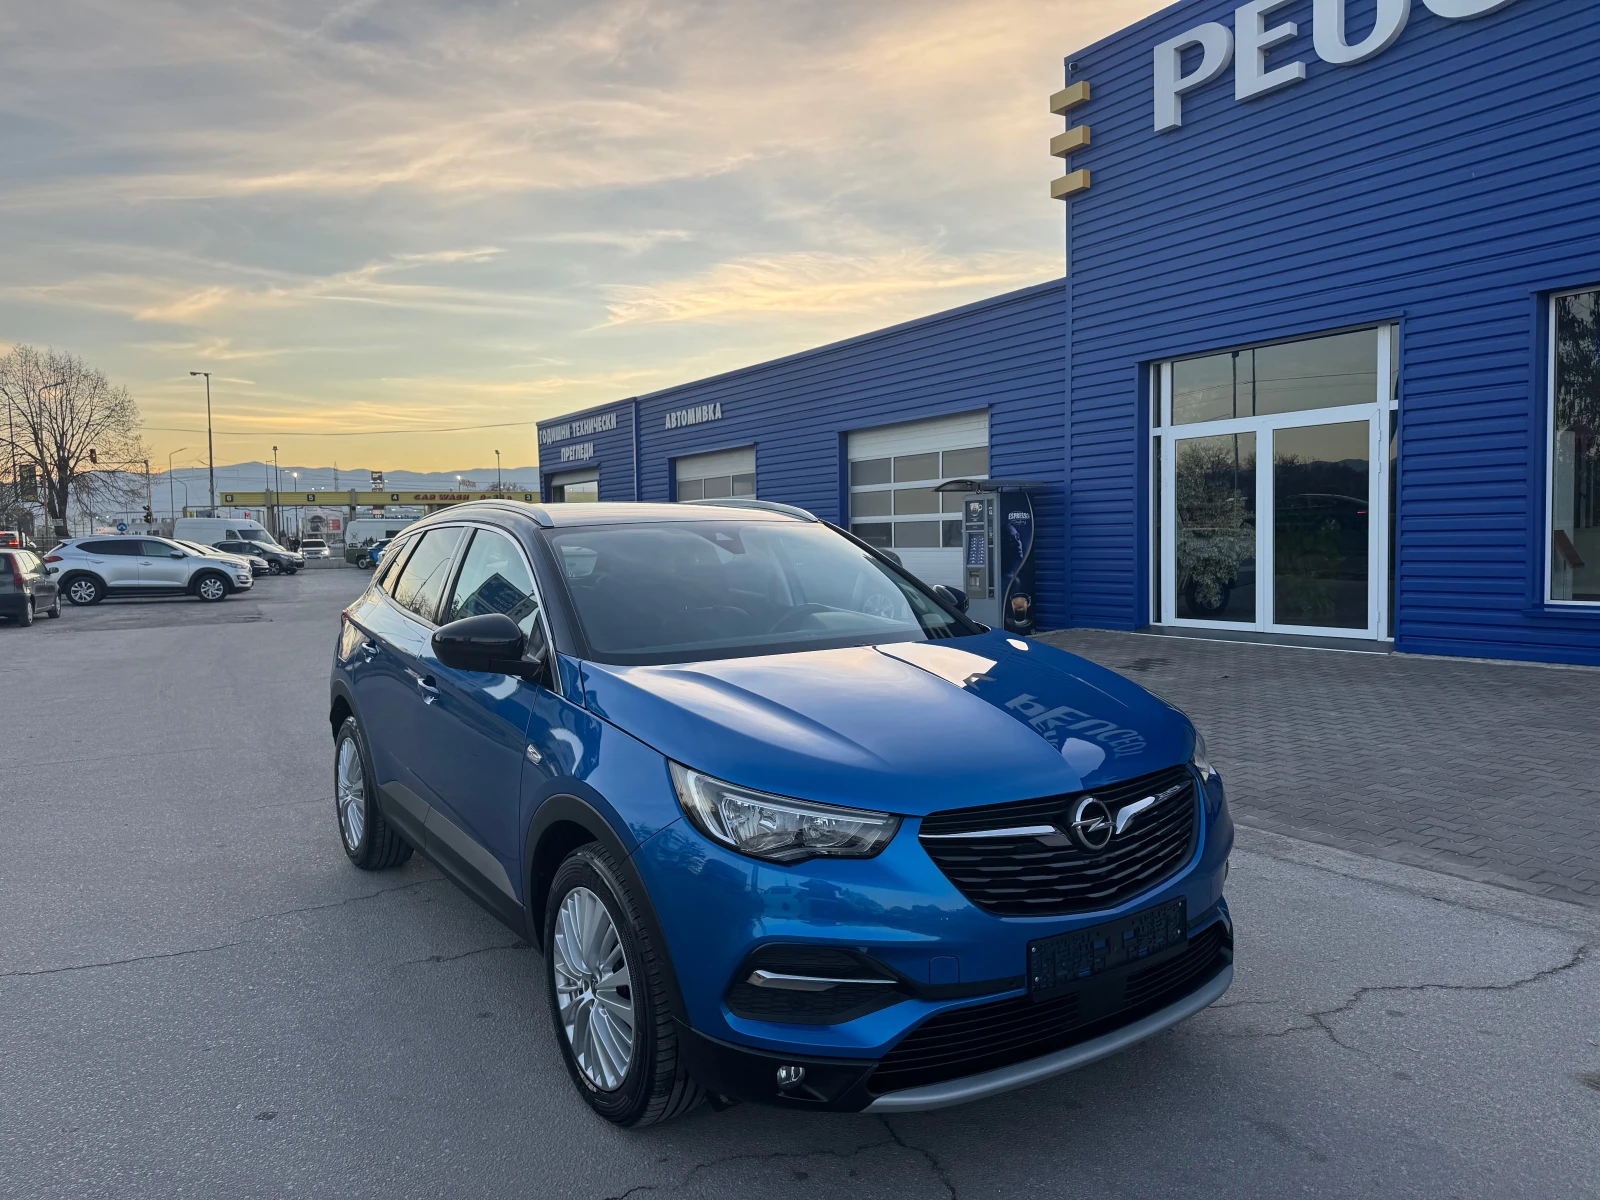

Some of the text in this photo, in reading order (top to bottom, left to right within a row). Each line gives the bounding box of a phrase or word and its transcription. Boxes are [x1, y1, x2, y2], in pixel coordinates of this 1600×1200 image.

[1153, 0, 1516, 133] PEU
[539, 412, 617, 445] ГОДИШНИ ТЕХНИЧЕСКИ
[665, 402, 722, 430] АВТОМИВКА
[560, 442, 594, 462] ПРЕГЛЕДИ
